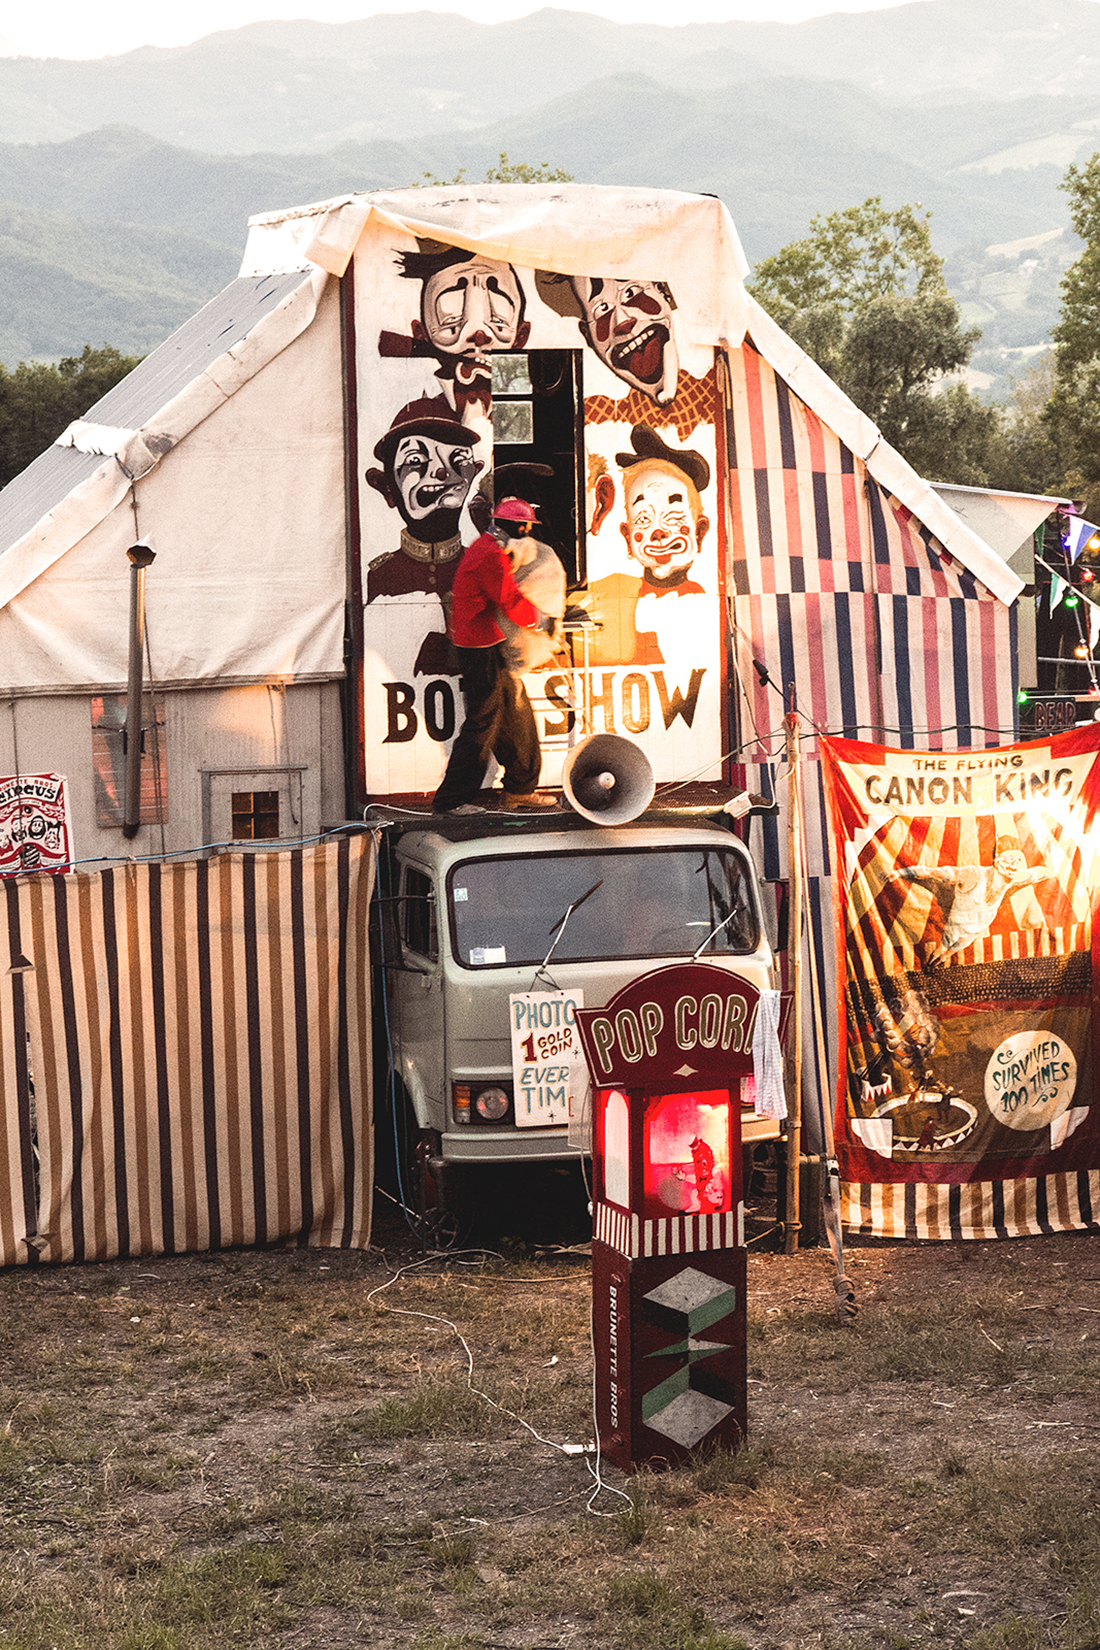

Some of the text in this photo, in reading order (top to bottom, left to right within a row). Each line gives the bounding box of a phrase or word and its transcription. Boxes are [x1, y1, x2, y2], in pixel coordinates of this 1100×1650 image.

[543, 668, 707, 736] SHOW
[1035, 701, 1076, 731] BEAR
[913, 755, 1024, 771] THE FLYING
[865, 768, 1073, 805] CANON KING
[512, 999, 577, 1030] PHOTO
[520, 1027, 572, 1062] 1 GOLD
[541, 1037, 573, 1060] COIN
[591, 1002, 664, 1074] POP
[519, 1066, 569, 1086] EVER
[993, 1041, 1060, 1091] SURVIVED
[520, 1086, 569, 1115] TIM
[1001, 1086, 1029, 1113] 100
[609, 1285, 618, 1429] BRUNETTE BROS
